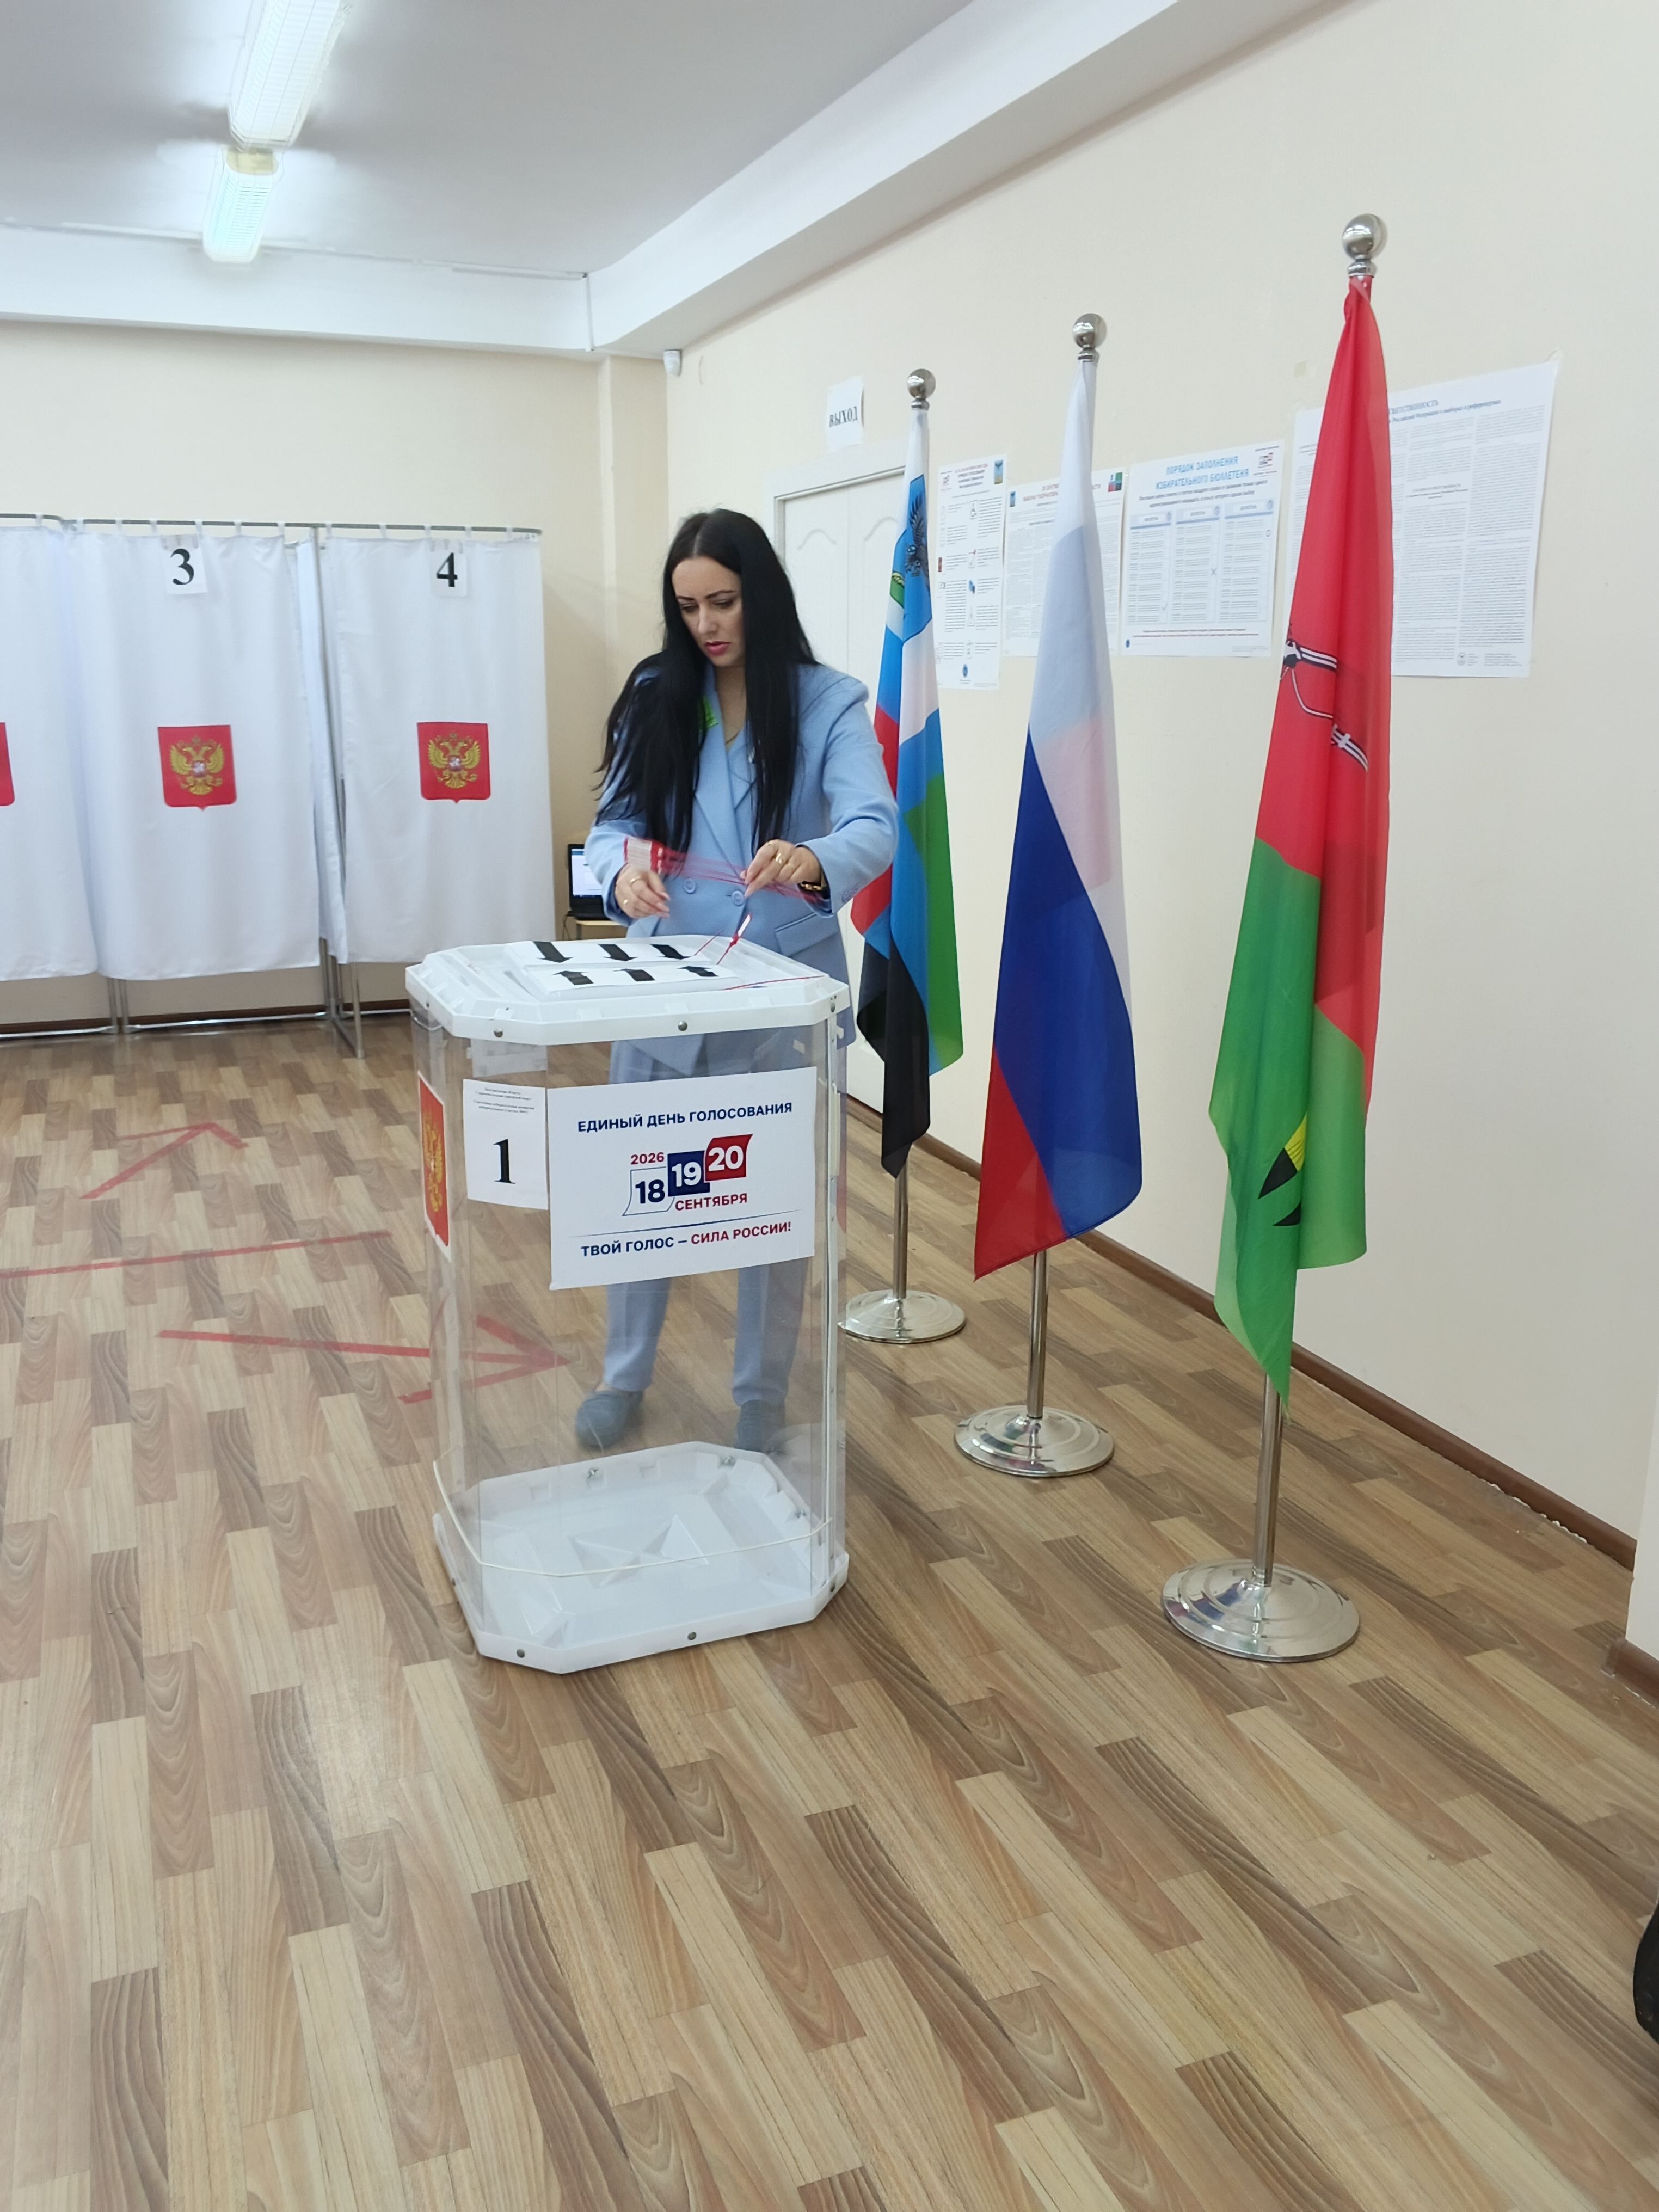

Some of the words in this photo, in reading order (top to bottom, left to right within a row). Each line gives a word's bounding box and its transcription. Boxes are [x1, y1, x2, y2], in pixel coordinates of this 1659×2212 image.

[829, 406, 858, 427] ВЫХОД
[170, 548, 195, 586] 3
[437, 552, 458, 588] 4
[577, 1114, 643, 1132] ЕДИНЫЙ
[647, 1113, 685, 1128] ДЕНЬ
[689, 1102, 792, 1122] ГОЛОСОВАНИЯ
[493, 1139, 515, 1184] 1
[630, 1152, 665, 1165] 2026
[635, 1179, 665, 1204] 18
[671, 1162, 702, 1188] 19
[708, 1145, 744, 1172] 20
[675, 1193, 748, 1211] СЕНТЯБРЯ
[581, 1240, 622, 1257] ТВОЙ
[625, 1237, 674, 1252] ГОЛОС
[691, 1231, 729, 1245] СИЛА
[733, 1221, 791, 1240] РОССИИ!
